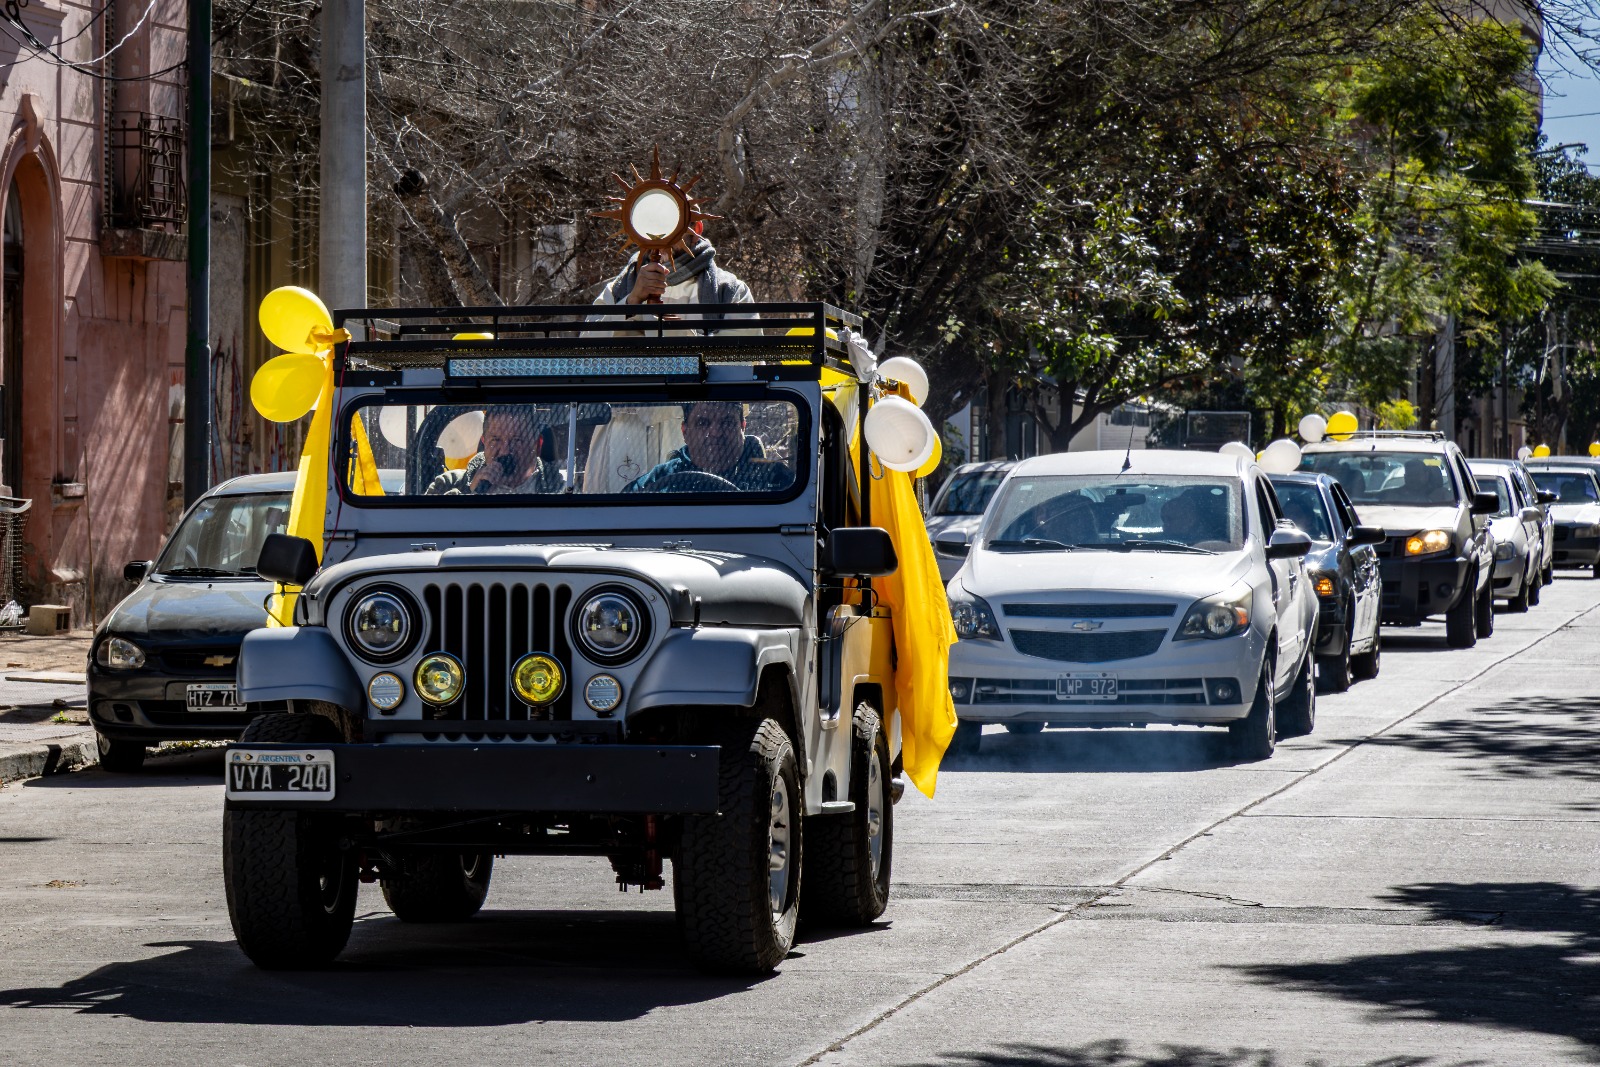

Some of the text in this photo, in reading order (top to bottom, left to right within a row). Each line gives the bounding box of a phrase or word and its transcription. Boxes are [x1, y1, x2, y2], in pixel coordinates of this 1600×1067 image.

[1058, 679, 1115, 694] LWP 972
[189, 691, 243, 706] HTZ 71
[260, 755, 302, 763] ARGENTINA
[233, 765, 328, 791] VYA 244
